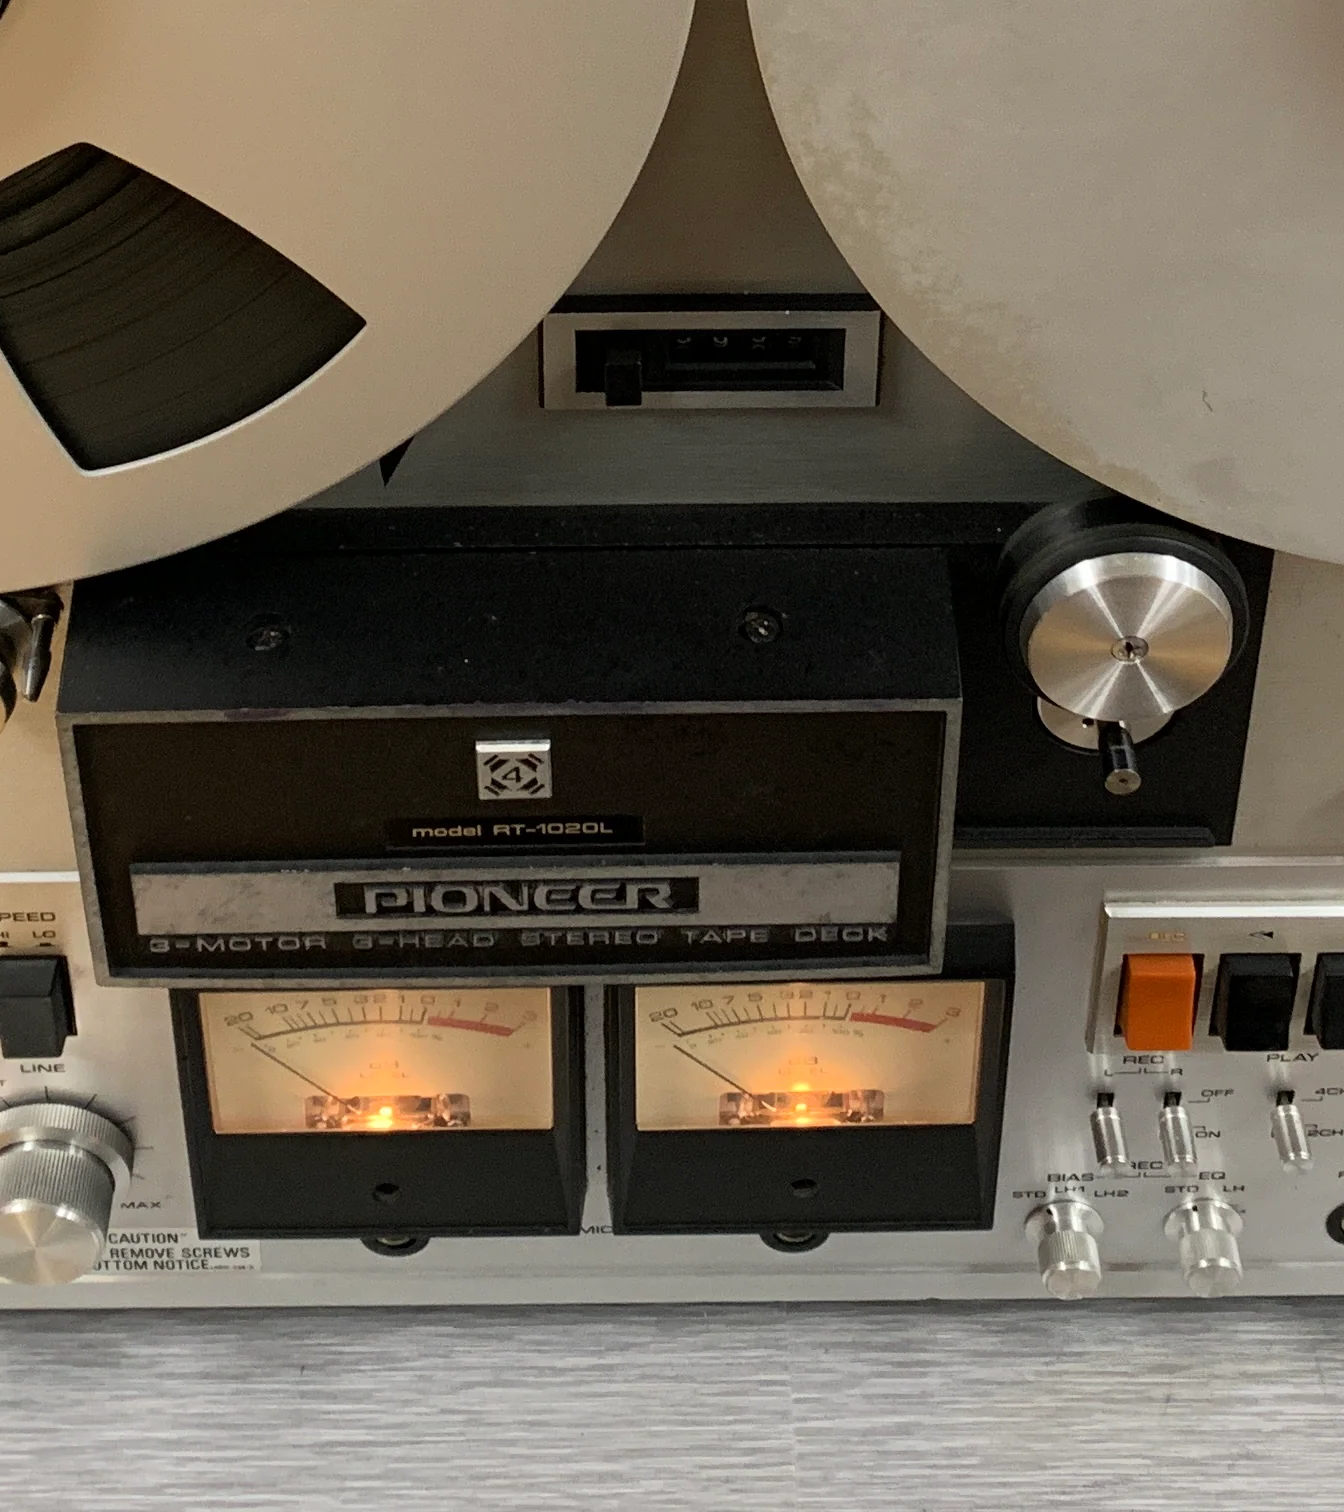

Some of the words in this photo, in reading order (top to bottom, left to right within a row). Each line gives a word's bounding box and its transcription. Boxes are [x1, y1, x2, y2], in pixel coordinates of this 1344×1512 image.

[412, 824, 482, 838] model
[492, 821, 614, 836] RT-1020L
[362, 879, 675, 915] PIONEER
[32, 930, 56, 939] LO
[521, 928, 659, 947] STEREO
[682, 927, 770, 945] TAPE
[793, 925, 889, 943] DECK
[690, 999, 714, 1011] 10
[845, 990, 862, 1001] 0
[1122, 1055, 1165, 1065] REC
[1266, 1052, 1321, 1063] PLAY
[19, 1063, 67, 1074] LINE
[1200, 1088, 1235, 1098] OFF
[1195, 1130, 1221, 1139] ON
[1047, 1172, 1094, 1182] BIAS
[1198, 1171, 1226, 1181] EQ
[1164, 1185, 1200, 1194] STD
[1222, 1184, 1246, 1193] LH
[120, 1201, 163, 1209] MAX
[108, 1232, 179, 1245] CAUTION
[109, 1247, 175, 1259] REMOVE
[181, 1246, 251, 1259] SCREWS
